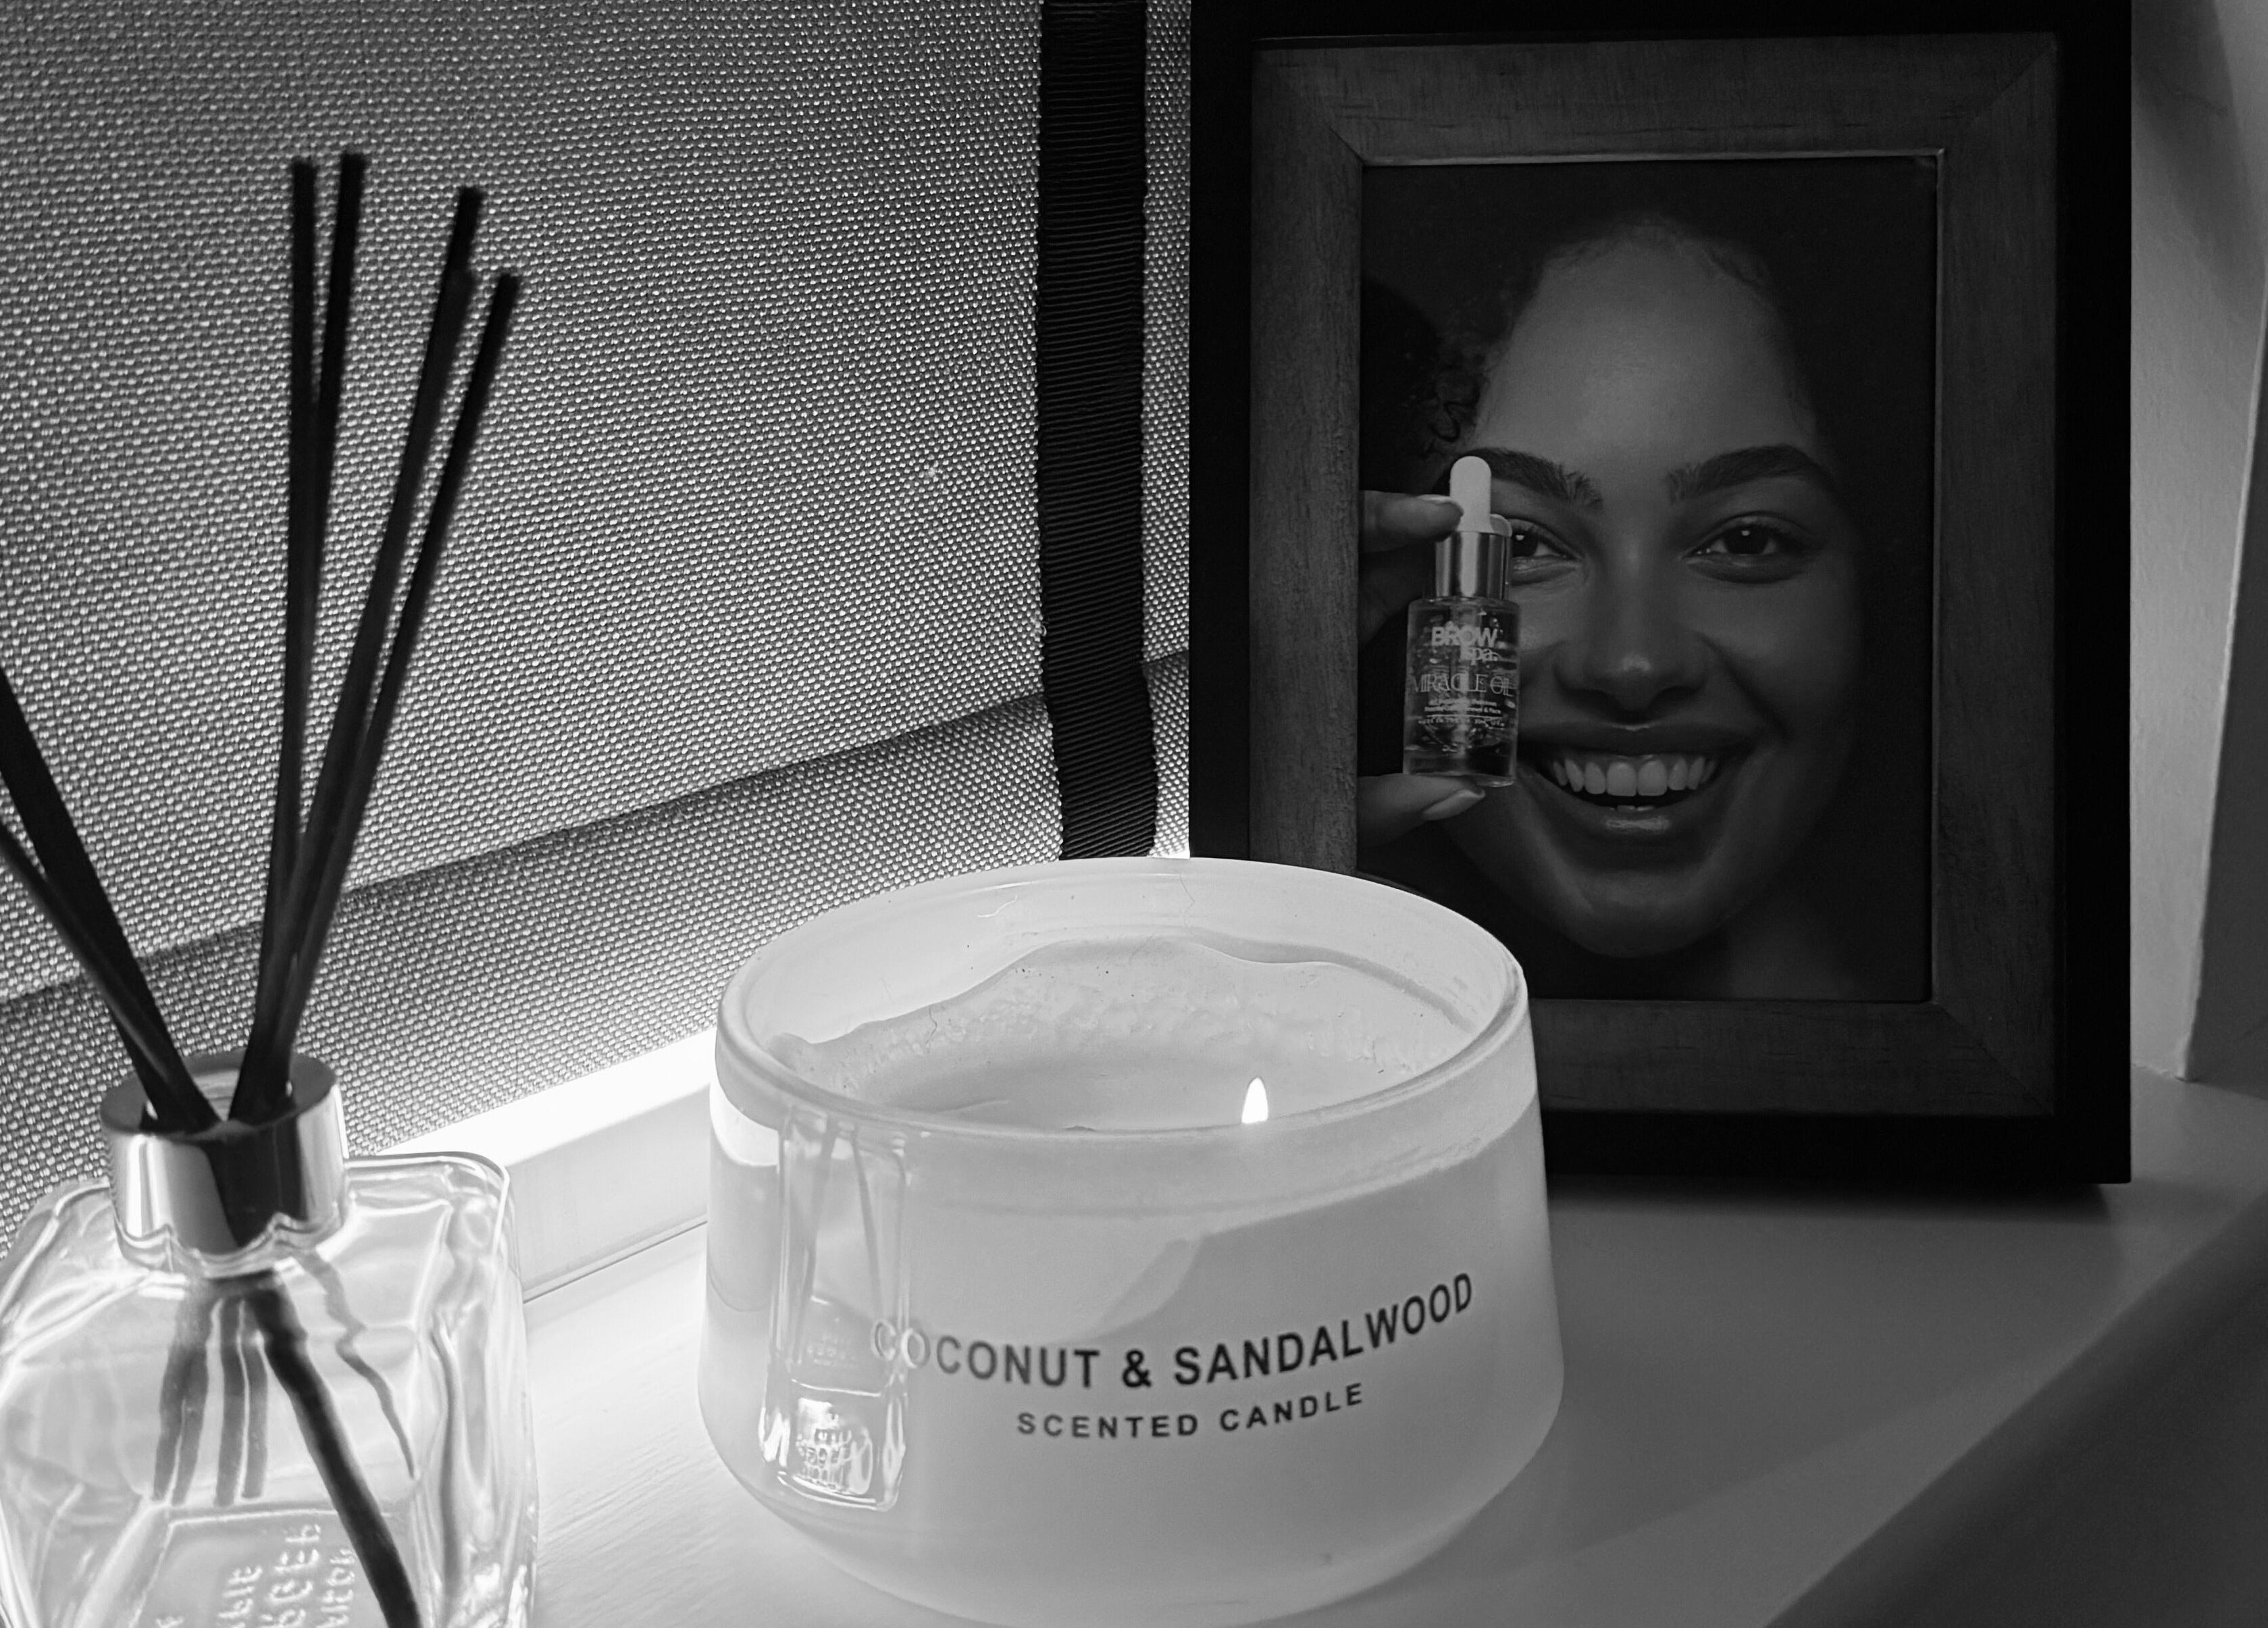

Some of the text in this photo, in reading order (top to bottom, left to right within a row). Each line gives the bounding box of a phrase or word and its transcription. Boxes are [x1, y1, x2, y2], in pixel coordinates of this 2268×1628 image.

[1431, 626, 1498, 648] BROW
[871, 1319, 1101, 1388] COCONUT
[1122, 1348, 1152, 1388] &
[1175, 1273, 1472, 1385] SANDALWOOD
[1017, 1382, 1363, 1439] SCENTED CANDLE
